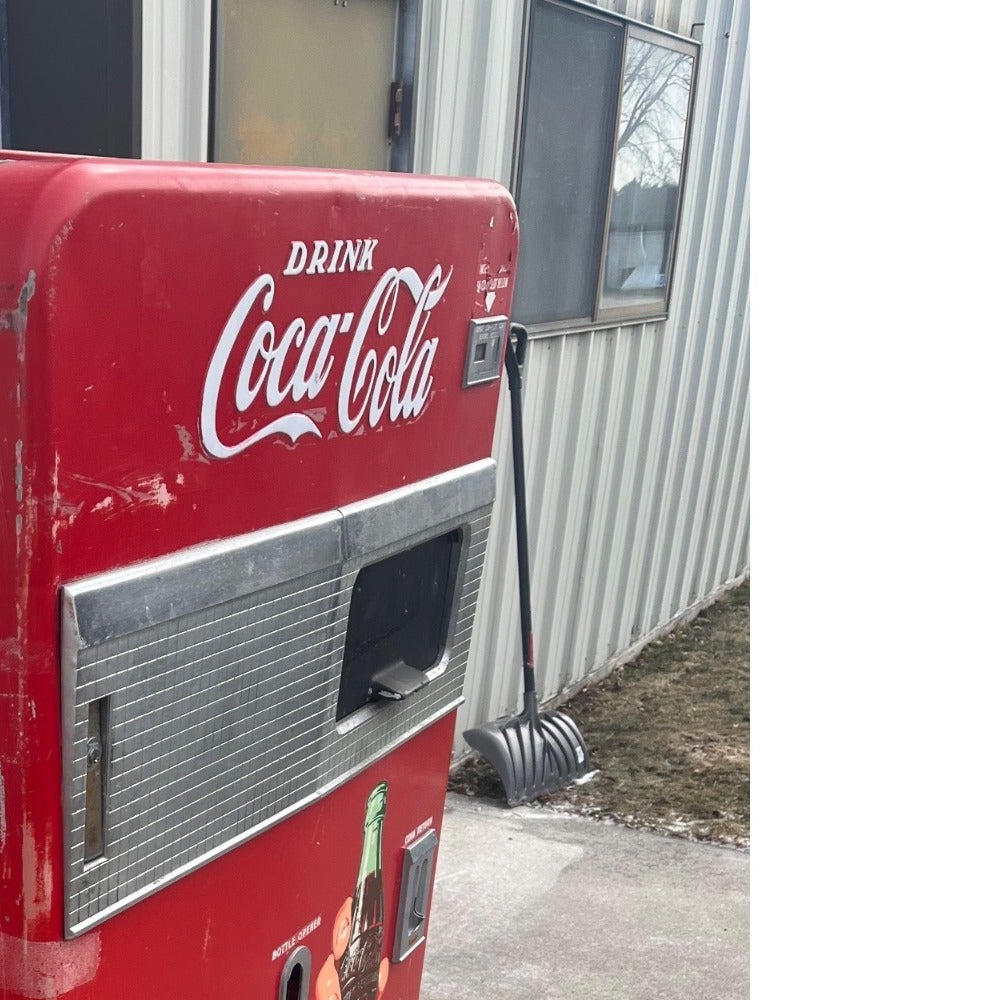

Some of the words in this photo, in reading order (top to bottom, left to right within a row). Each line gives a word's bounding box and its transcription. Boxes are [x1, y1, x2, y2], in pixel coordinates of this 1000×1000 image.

[283, 239, 378, 275] DRINK
[271, 936, 296, 961] BOTTLE
[297, 915, 322, 941] OPENER
